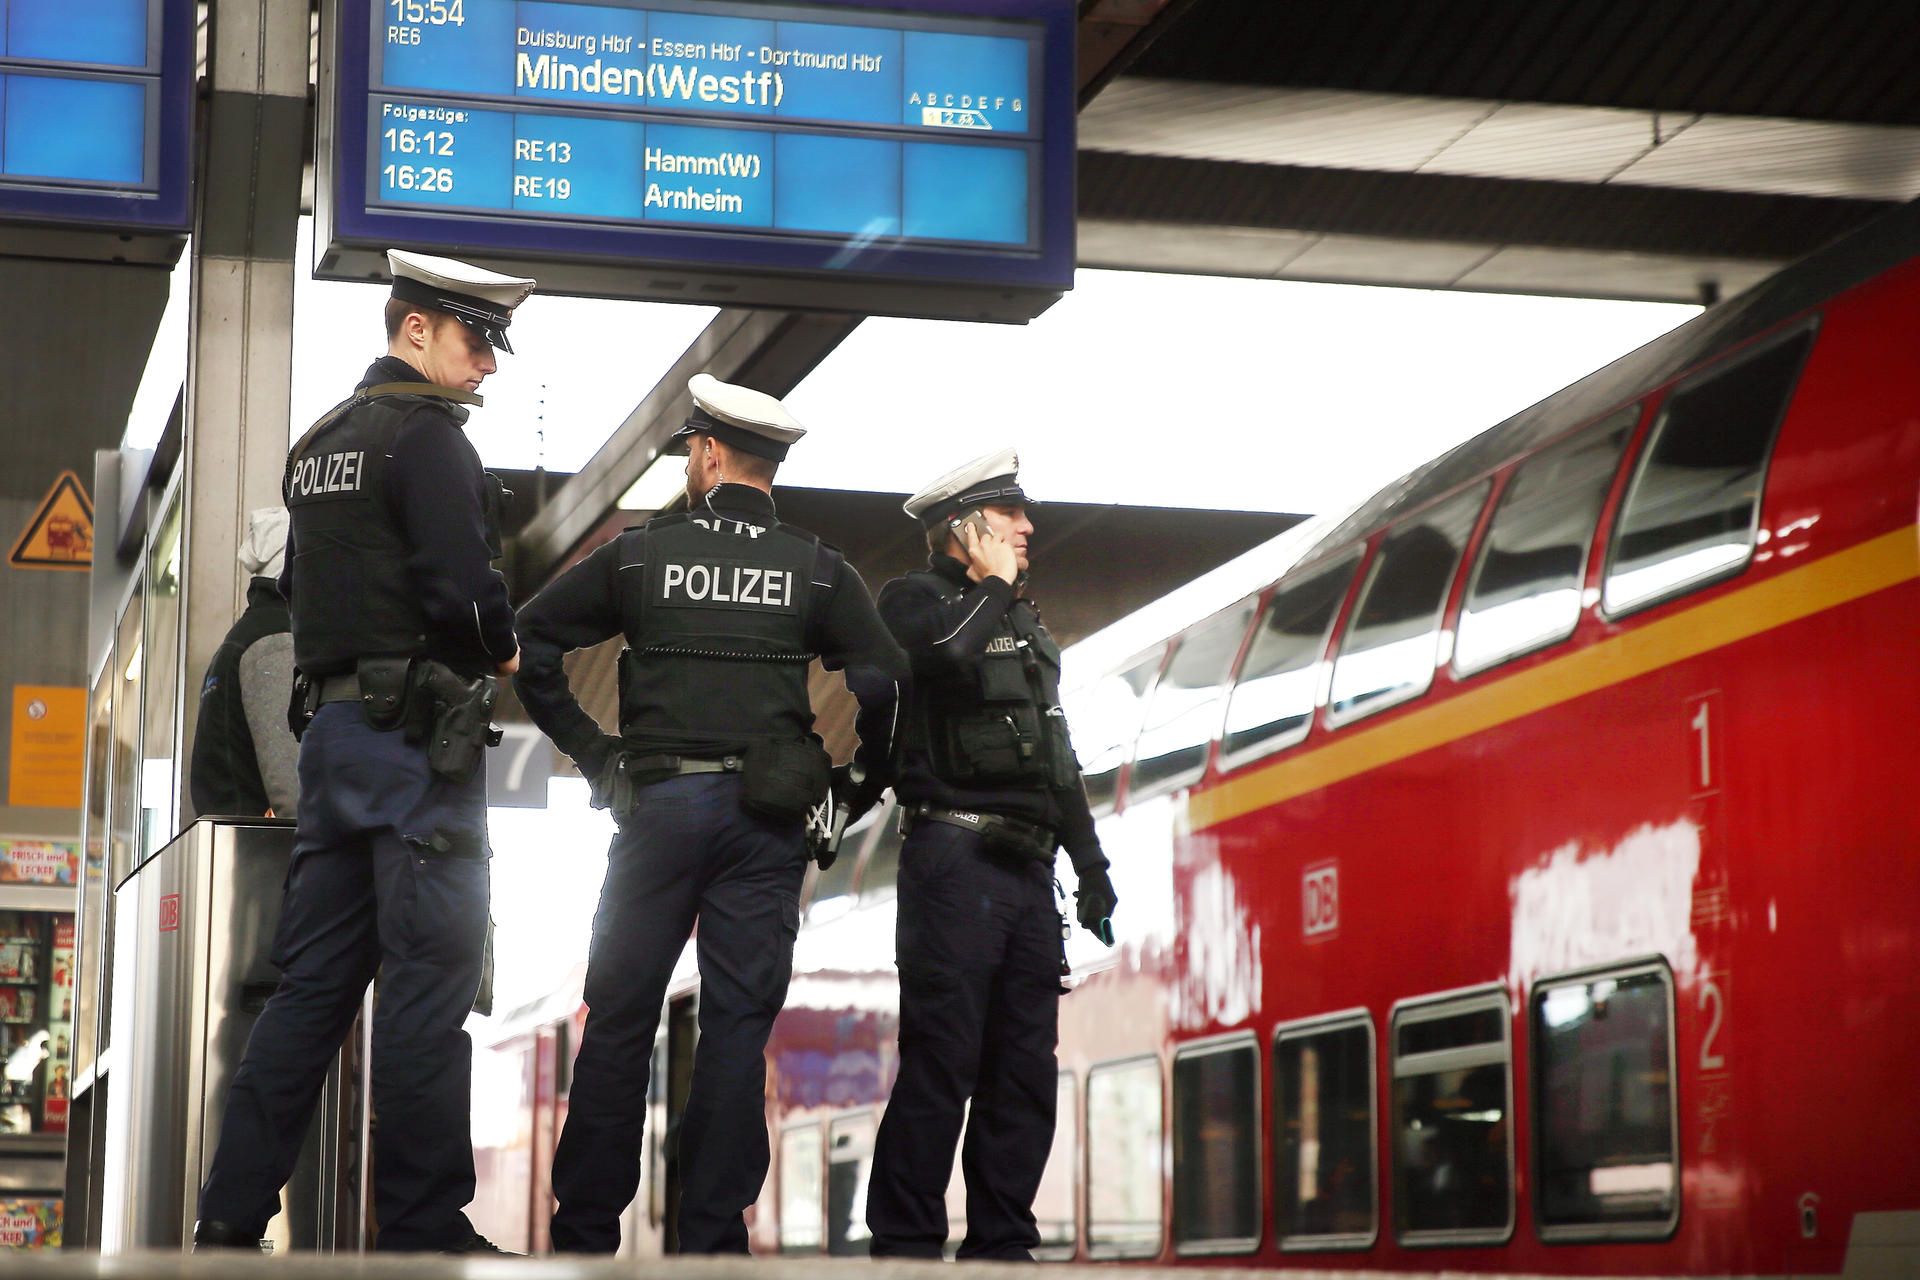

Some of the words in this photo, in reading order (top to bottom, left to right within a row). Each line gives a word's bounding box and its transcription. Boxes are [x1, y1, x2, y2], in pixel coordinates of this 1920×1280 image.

[388, 26, 421, 46] RE6
[391, 0, 465, 27] 15:54
[517, 27, 596, 55] Duisburg
[601, 34, 632, 54] Hbf
[652, 38, 706, 60] Essen
[710, 42, 741, 62] Hbf
[760, 46, 848, 70] Dortmund
[852, 53, 882, 73] Hbf
[516, 52, 784, 107] Minden(Westf)
[909, 92, 921, 105] A
[927, 93, 937, 106] B
[945, 94, 954, 107] C
[961, 95, 972, 108] D
[979, 96, 988, 109] E
[995, 98, 1004, 110] F
[1012, 98, 1022, 112] G
[383, 103, 469, 125] Folgezüge:
[385, 128, 454, 156] 16:12
[644, 148, 760, 178] Hamm(W)
[384, 164, 453, 193] 16:26
[643, 183, 744, 213] Arnheim
[290, 451, 364, 498] POLIZEI
[663, 564, 793, 607] POLIZEI
[499, 723, 542, 792] 7
[1692, 702, 1710, 787] 1
[160, 895, 179, 931] DB
[1698, 983, 1724, 1070] 2
